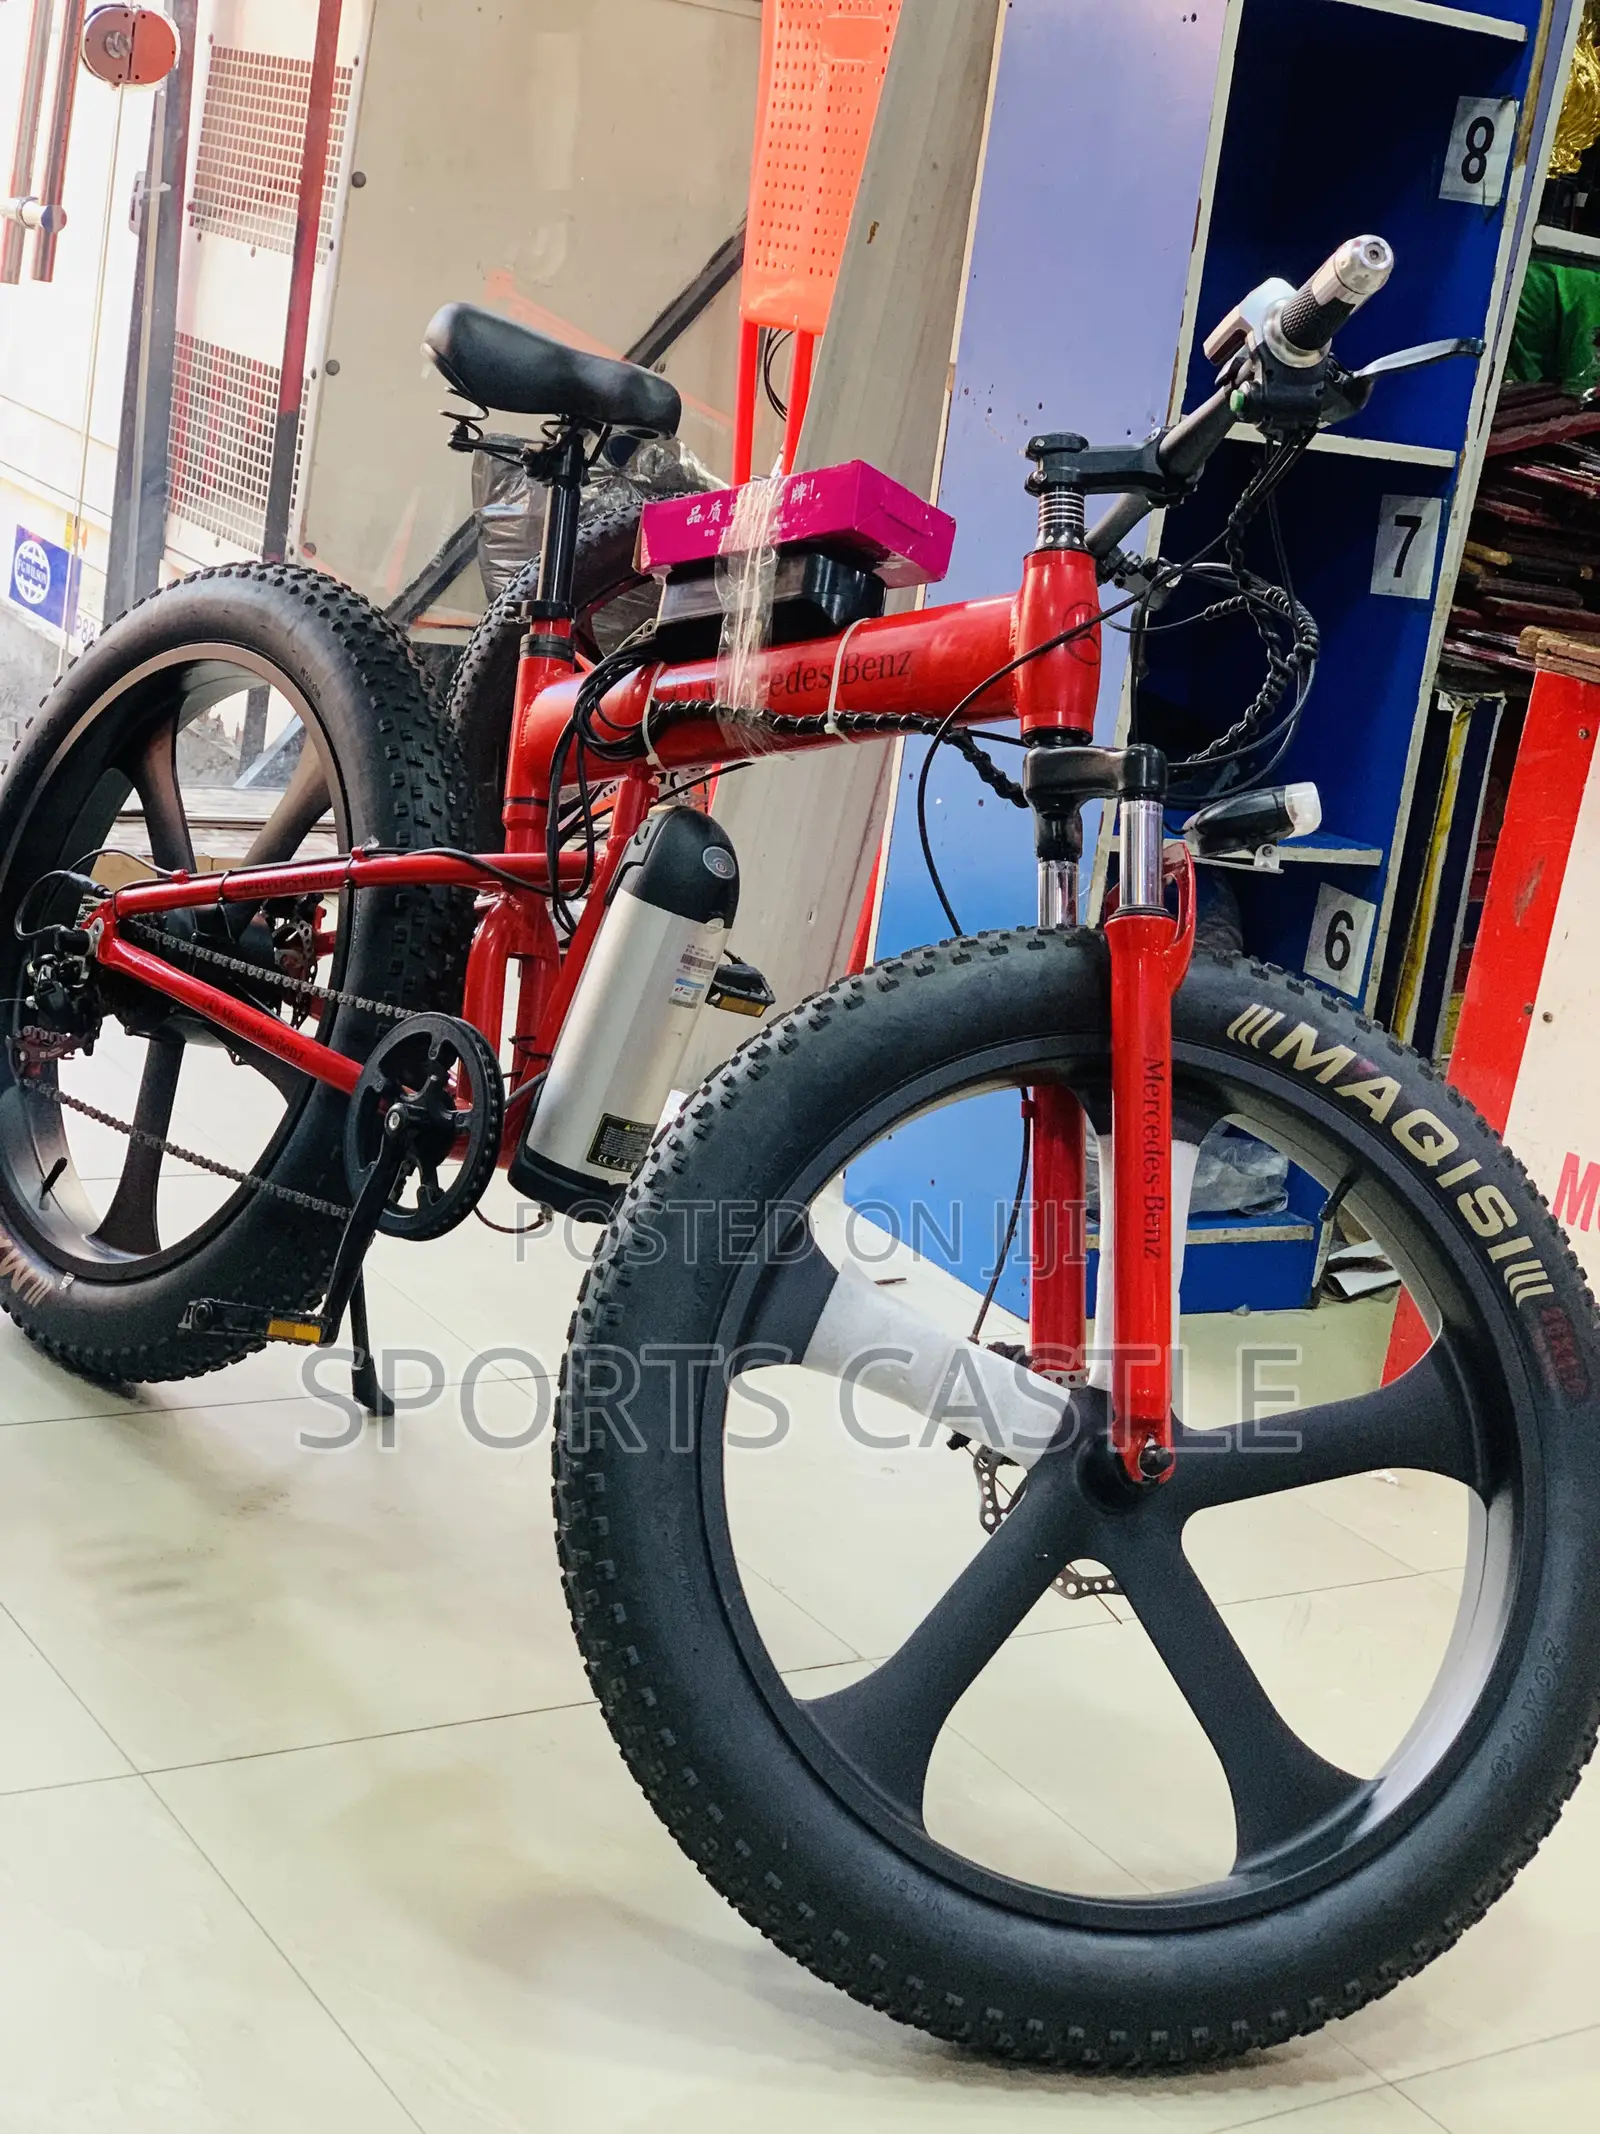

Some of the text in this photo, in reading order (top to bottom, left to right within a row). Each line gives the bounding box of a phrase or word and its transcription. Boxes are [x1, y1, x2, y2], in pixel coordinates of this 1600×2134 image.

[1461, 116, 1495, 184] 8
[1393, 514, 1423, 578] 7
[1324, 909, 1355, 971] 6
[1143, 1057, 1165, 1260] Mercedes-Benz
[1269, 1021, 1535, 1264] MAQISI
